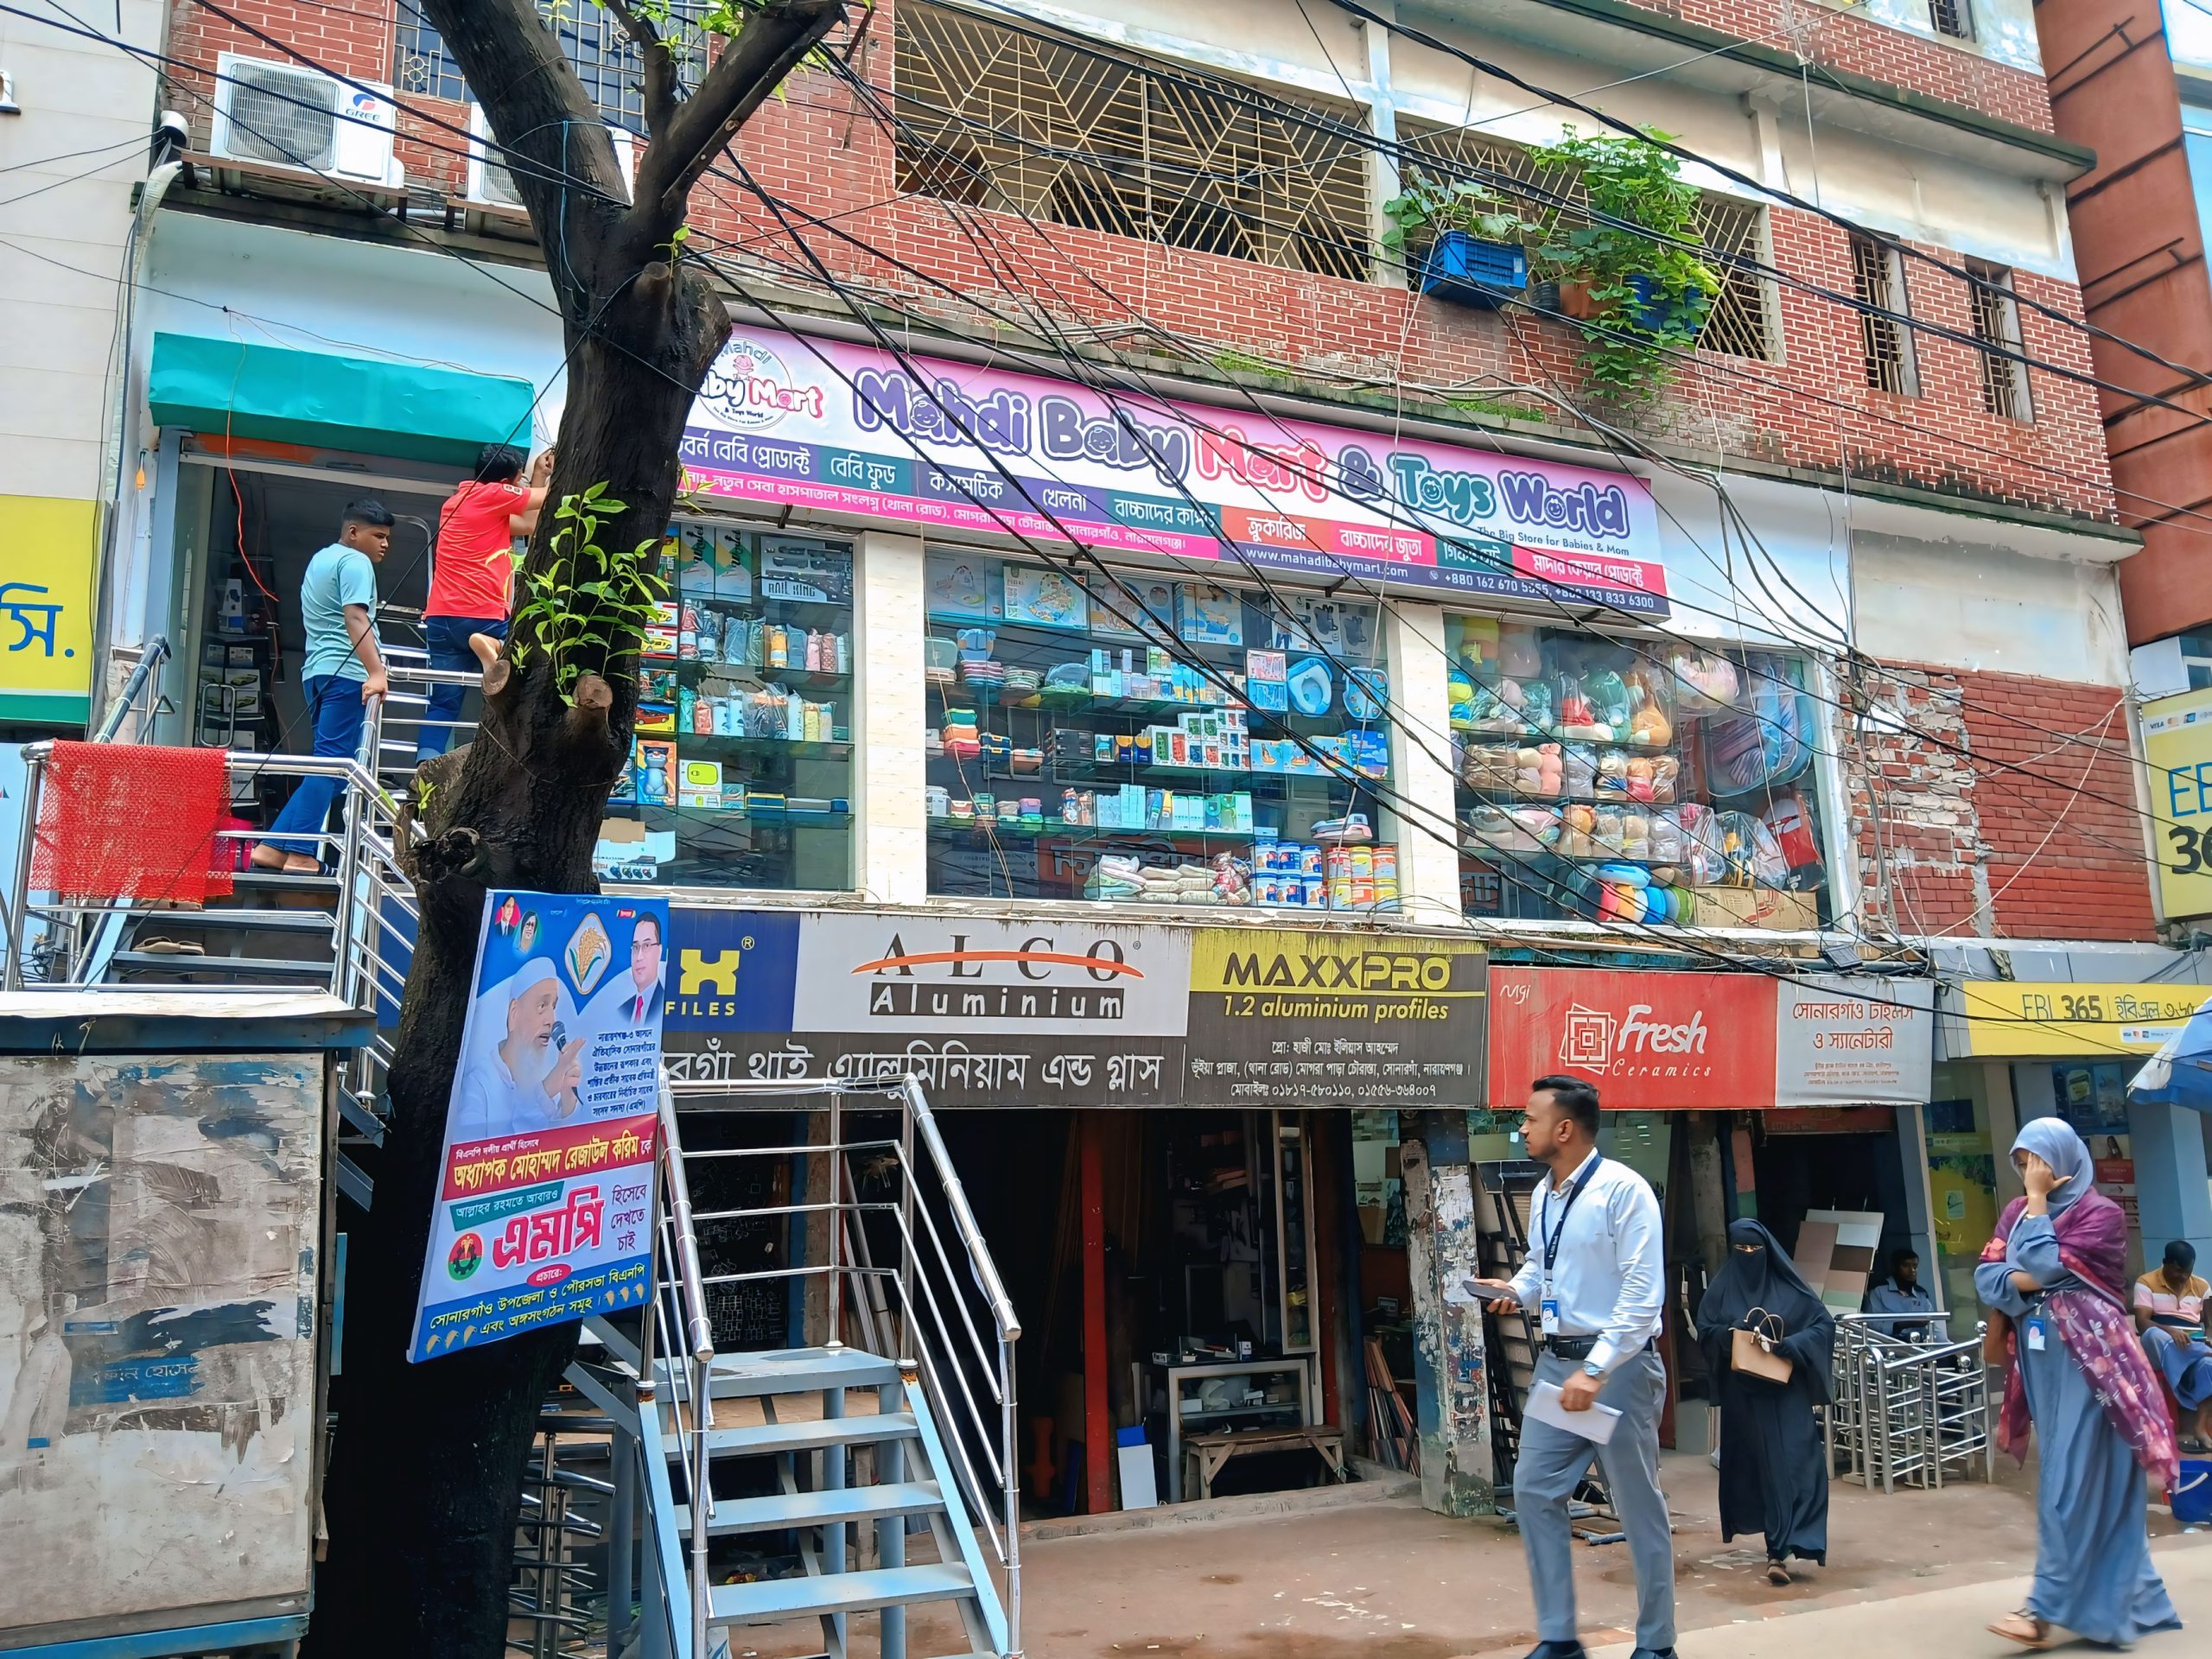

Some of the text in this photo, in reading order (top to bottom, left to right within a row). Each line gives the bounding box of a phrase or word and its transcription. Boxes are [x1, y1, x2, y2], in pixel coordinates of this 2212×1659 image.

[346, 109, 380, 122] GREE
[698, 369, 746, 407] by
[749, 377, 823, 418] Mart
[677, 431, 810, 475] বর্ন বেবি প্রোডাক্ট
[853, 365, 1630, 538] Mahdi Baby Mart & Toys World
[830, 453, 896, 490] বেবি ফুড
[712, 475, 743, 492] নতুন
[747, 480, 775, 493] সেবা
[778, 484, 838, 502] হাসপাতাল
[842, 492, 880, 512] সংলগ্ন
[882, 496, 913, 513] (থানা
[1042, 488, 1087, 512] খেলনা
[1114, 499, 1173, 524] বাচ্চাদের
[1339, 529, 1422, 562] বাচ্চাদের জুতা
[1478, 526, 1630, 556] The Big Store for Babies & Mom
[1445, 573, 1472, 586] +880
[1478, 576, 1495, 589] 162
[1498, 579, 1518, 592] 670
[1605, 591, 1626, 605] 833
[1629, 594, 1654, 609] 6300
[2168, 762, 2212, 817] EB
[874, 932, 1124, 982] ALCO
[1223, 951, 1452, 991] MAXXPRO
[664, 1001, 735, 1016] FILES
[872, 983, 1121, 1017] Aluminium
[1224, 995, 1448, 1023] 1.2 aluminium profiles
[1793, 999, 1864, 1020] সোনারগাঁও
[2062, 995, 2103, 1020] 365
[1617, 1004, 1707, 1055] Fresh
[1813, 1026, 1893, 1049] ও স্যানেটারী
[748, 1039, 815, 1079] থাই
[1042, 1053, 1096, 1090] এন্ড
[1106, 1053, 1165, 1092] গ্লাস
[1244, 1060, 1268, 1079] (থানা
[1270, 1060, 1294, 1079] রোড)
[1296, 1062, 1324, 1077] মোগরা
[1612, 1058, 1712, 1077] Ceramics
[1272, 1084, 1355, 1099] ০১৮১৭-৫৮০১১০,
[1357, 1084, 1436, 1097] ০১৫৫৬-৩৬৪০০৭
[454, 1129, 652, 1191] অধ্যাপক মোহাম্মদ রেজাউল করিম কে
[456, 1145, 480, 1160] বিএনপি
[493, 1196, 524, 1211] রহমতে
[527, 1190, 557, 1205] আবারও
[612, 1184, 647, 1205] হিসেবে
[492, 1185, 605, 1269] এমপি
[611, 1208, 646, 1230] দেখতে
[618, 1231, 635, 1251] চাই
[430, 1263, 645, 1329] সোনারগাঁও উপজেলা ও পৌরসভা বিএনপি
[480, 1320, 504, 1335] এবং
[569, 1298, 593, 1316] সমূহ
